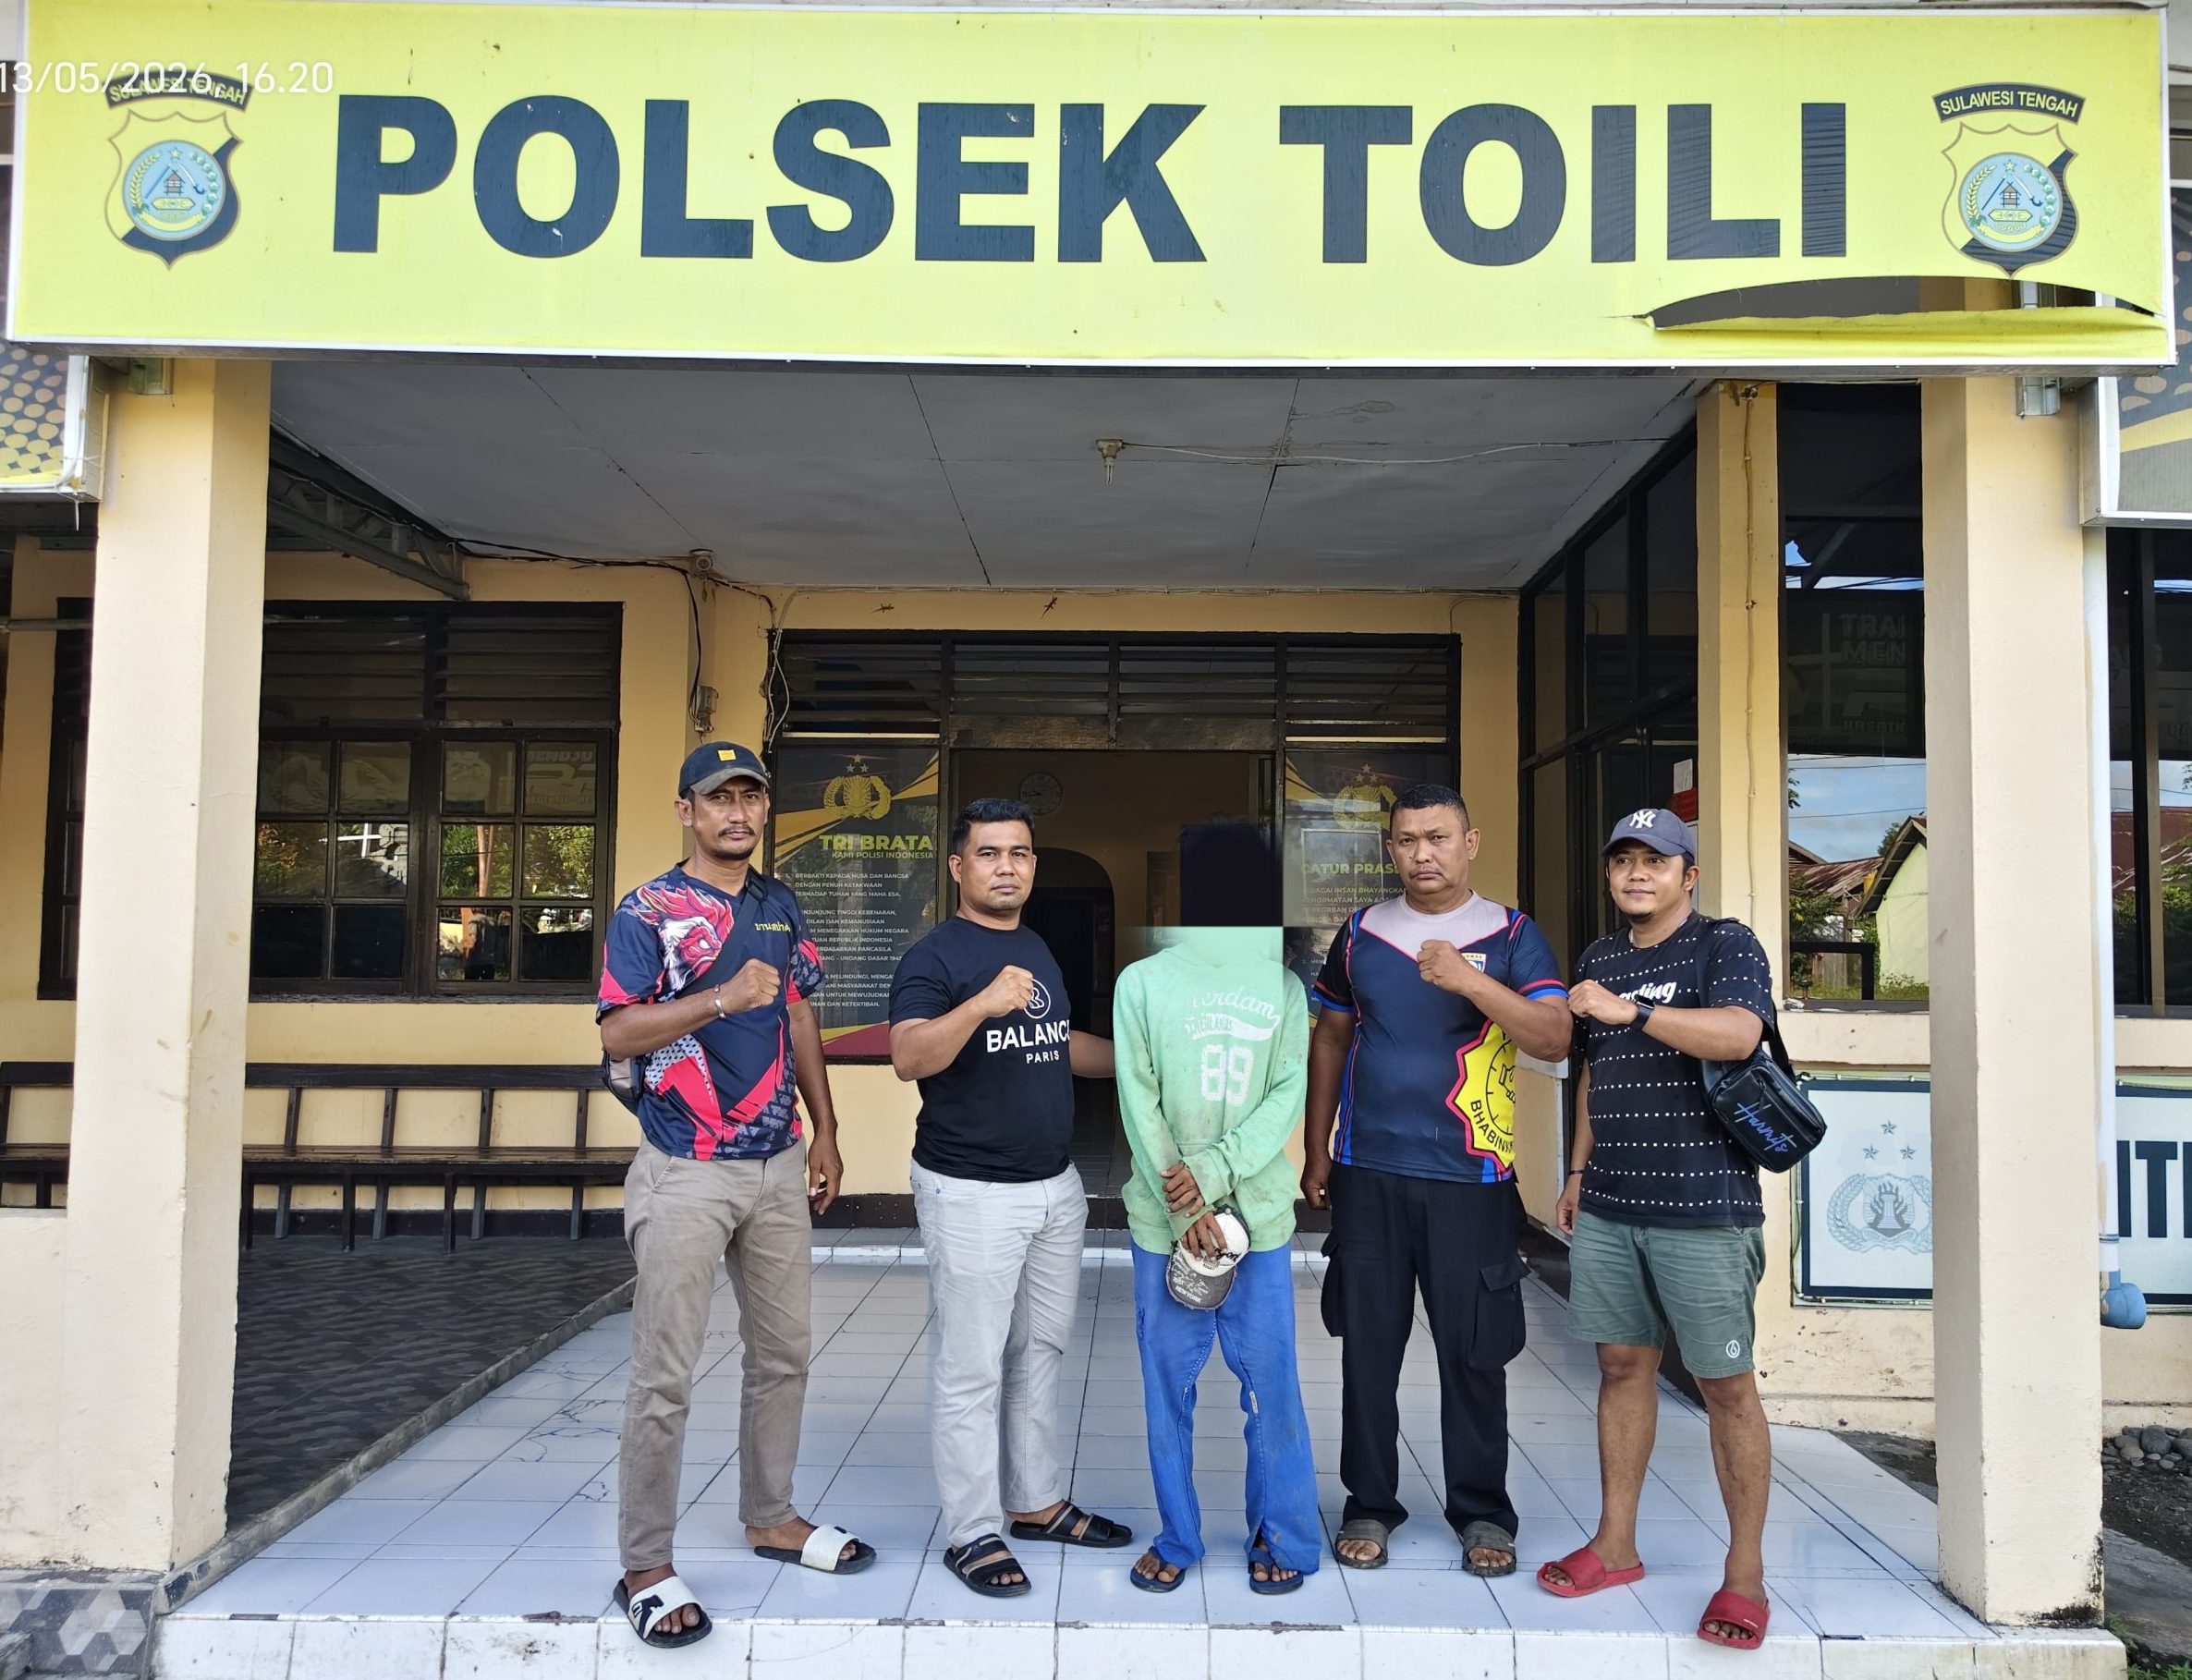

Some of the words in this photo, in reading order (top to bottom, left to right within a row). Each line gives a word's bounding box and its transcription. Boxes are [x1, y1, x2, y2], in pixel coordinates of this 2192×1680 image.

[1940, 91, 2014, 115] SULAWESI
[2016, 91, 2078, 117] TENGAH
[334, 94, 1207, 262] POLSEK
[1279, 103, 1846, 266] TOILI
[1629, 810, 1656, 828] NY
[819, 834, 855, 850] TRI
[860, 834, 934, 850] BRATA
[886, 851, 934, 859] INDONESIA
[1301, 863, 1349, 874] CATUR
[1026, 1050, 1060, 1064] PARIS
